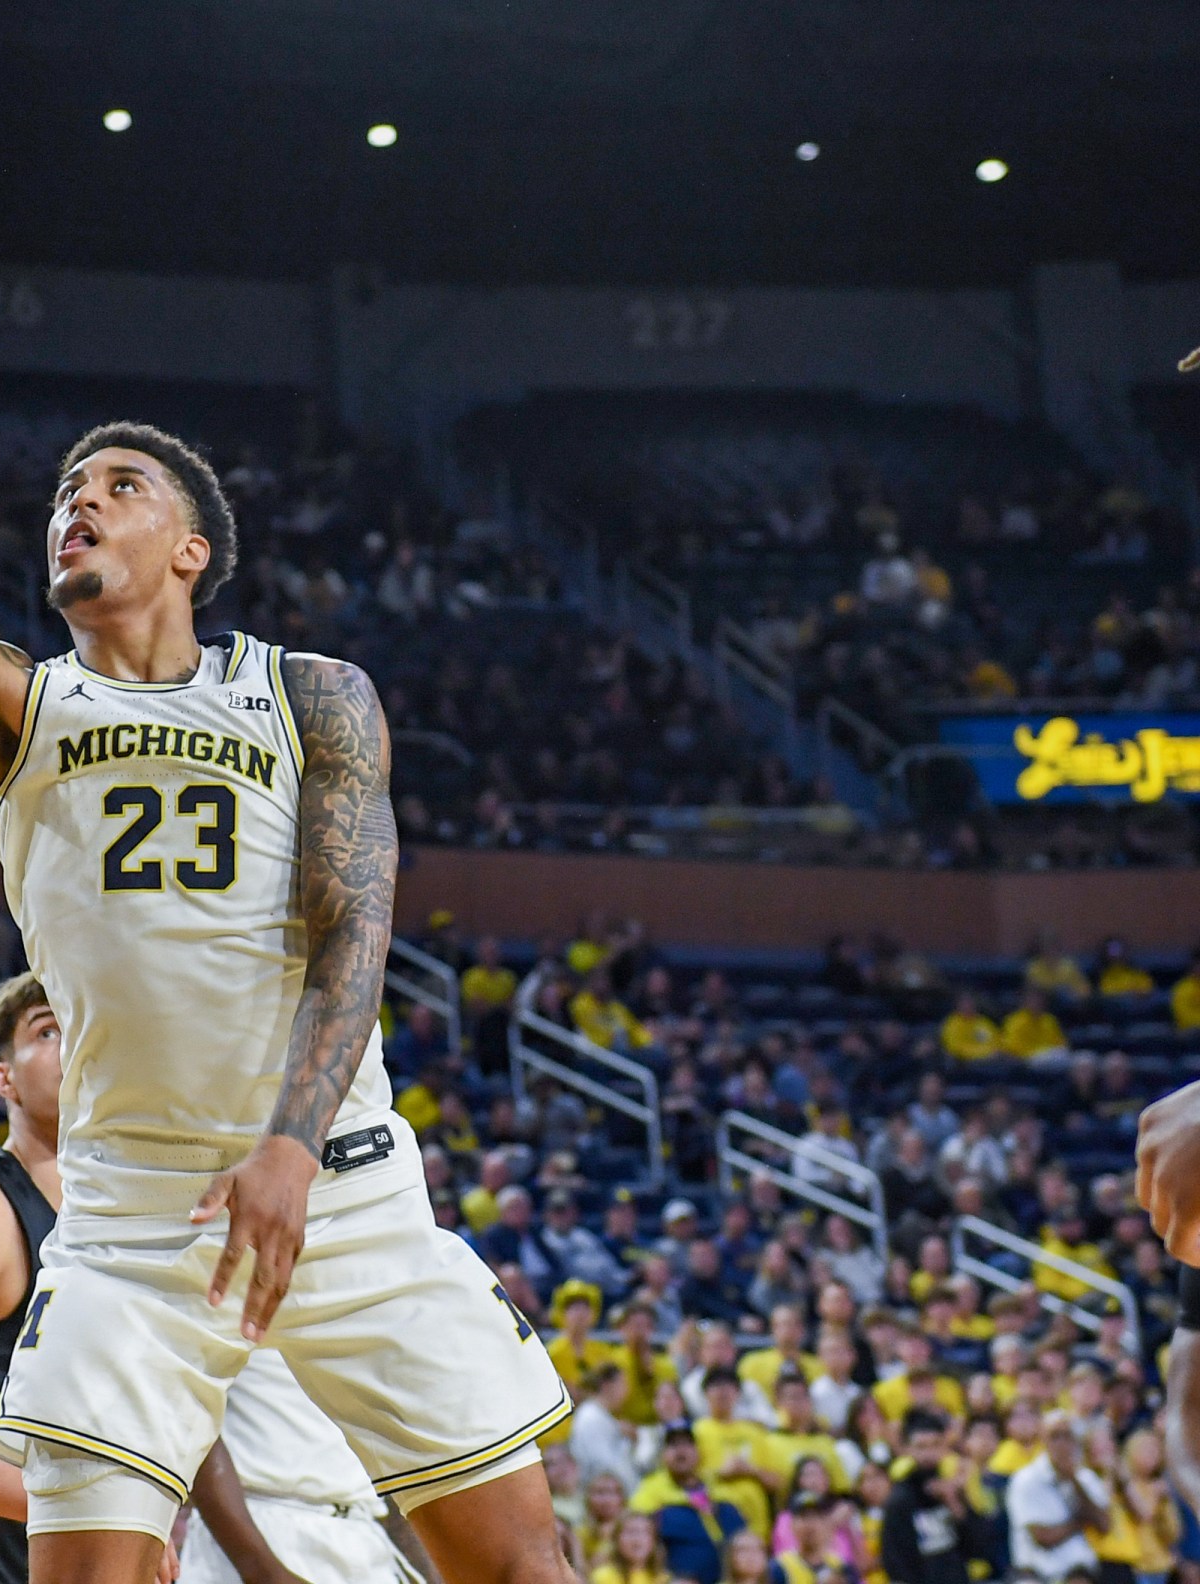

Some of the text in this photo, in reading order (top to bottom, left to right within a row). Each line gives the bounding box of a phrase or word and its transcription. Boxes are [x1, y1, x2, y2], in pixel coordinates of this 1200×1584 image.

[623, 298, 730, 349] 227
[57, 723, 276, 790] MICHIGAN
[101, 782, 239, 893] 23
[375, 1132, 389, 1144] 50
